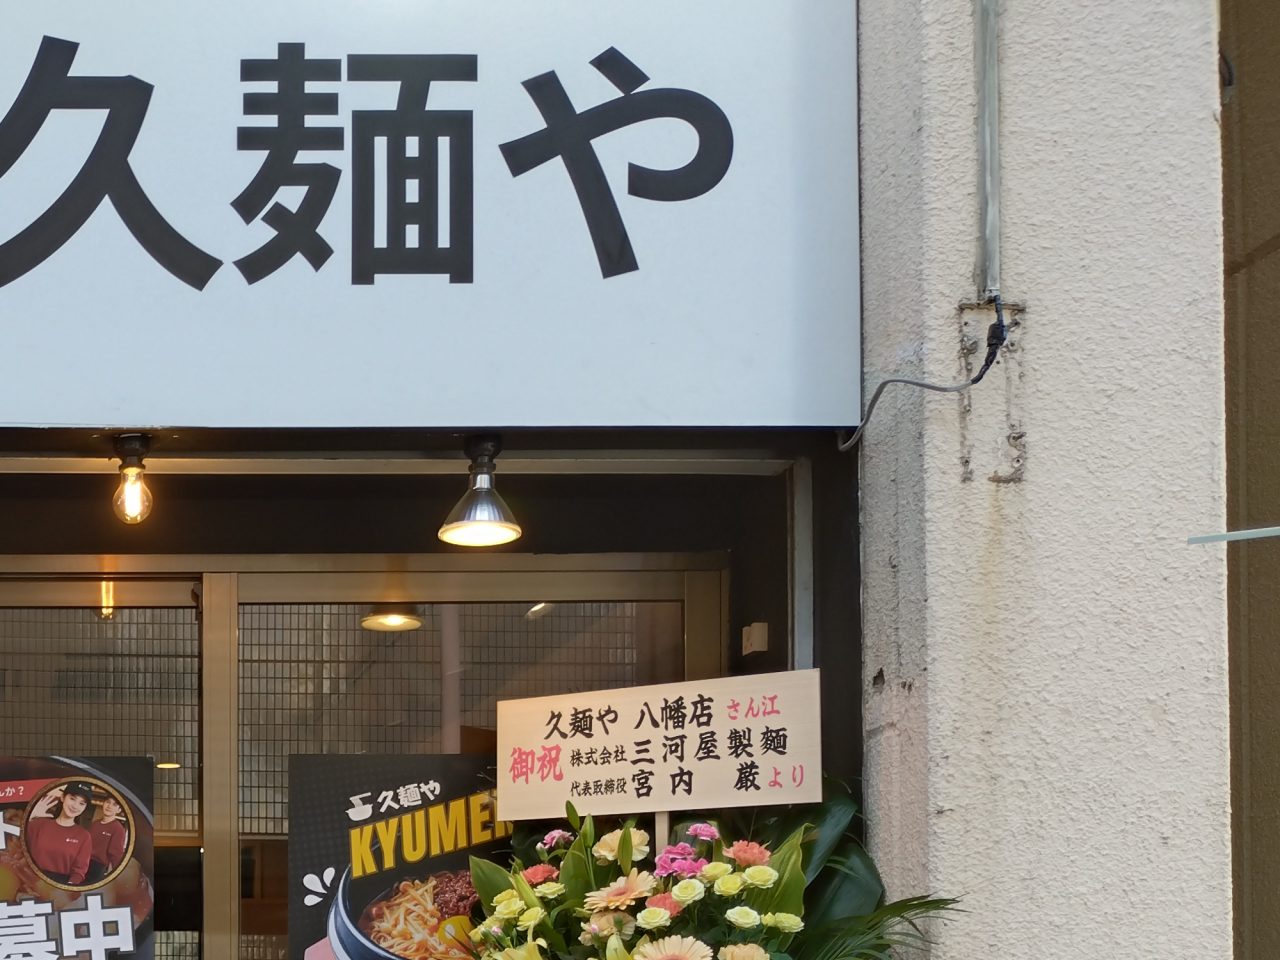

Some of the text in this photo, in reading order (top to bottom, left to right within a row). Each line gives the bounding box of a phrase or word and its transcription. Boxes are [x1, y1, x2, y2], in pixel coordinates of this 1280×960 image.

[544, 694, 781, 740] 久麺や 八幡店 さん江
[510, 744, 564, 784] 御祝
[570, 744, 628, 768] 株式会社
[377, 780, 441, 813] 久麺や
[570, 777, 628, 797] 代表取締役
[631, 766, 694, 798] 宮内
[767, 764, 805, 789] より
